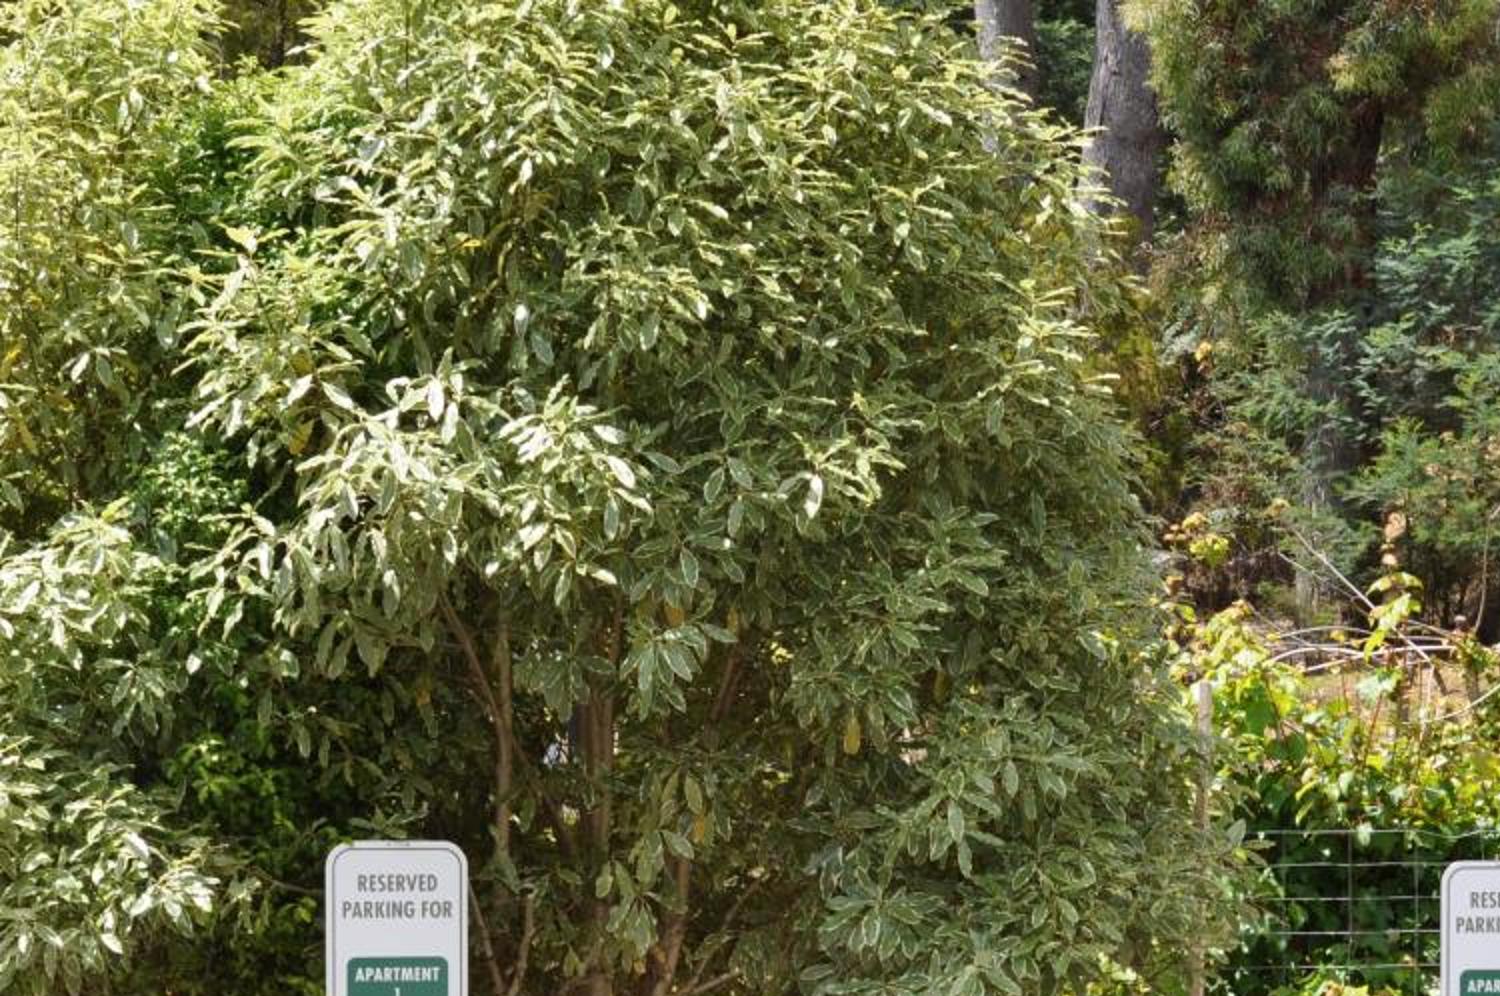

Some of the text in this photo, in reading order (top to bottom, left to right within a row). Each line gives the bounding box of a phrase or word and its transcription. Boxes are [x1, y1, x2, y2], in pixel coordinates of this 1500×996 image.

[358, 874, 438, 892] RESERVED
[342, 901, 453, 919] PARKING FOR
[355, 966, 440, 982] APARTMENT
